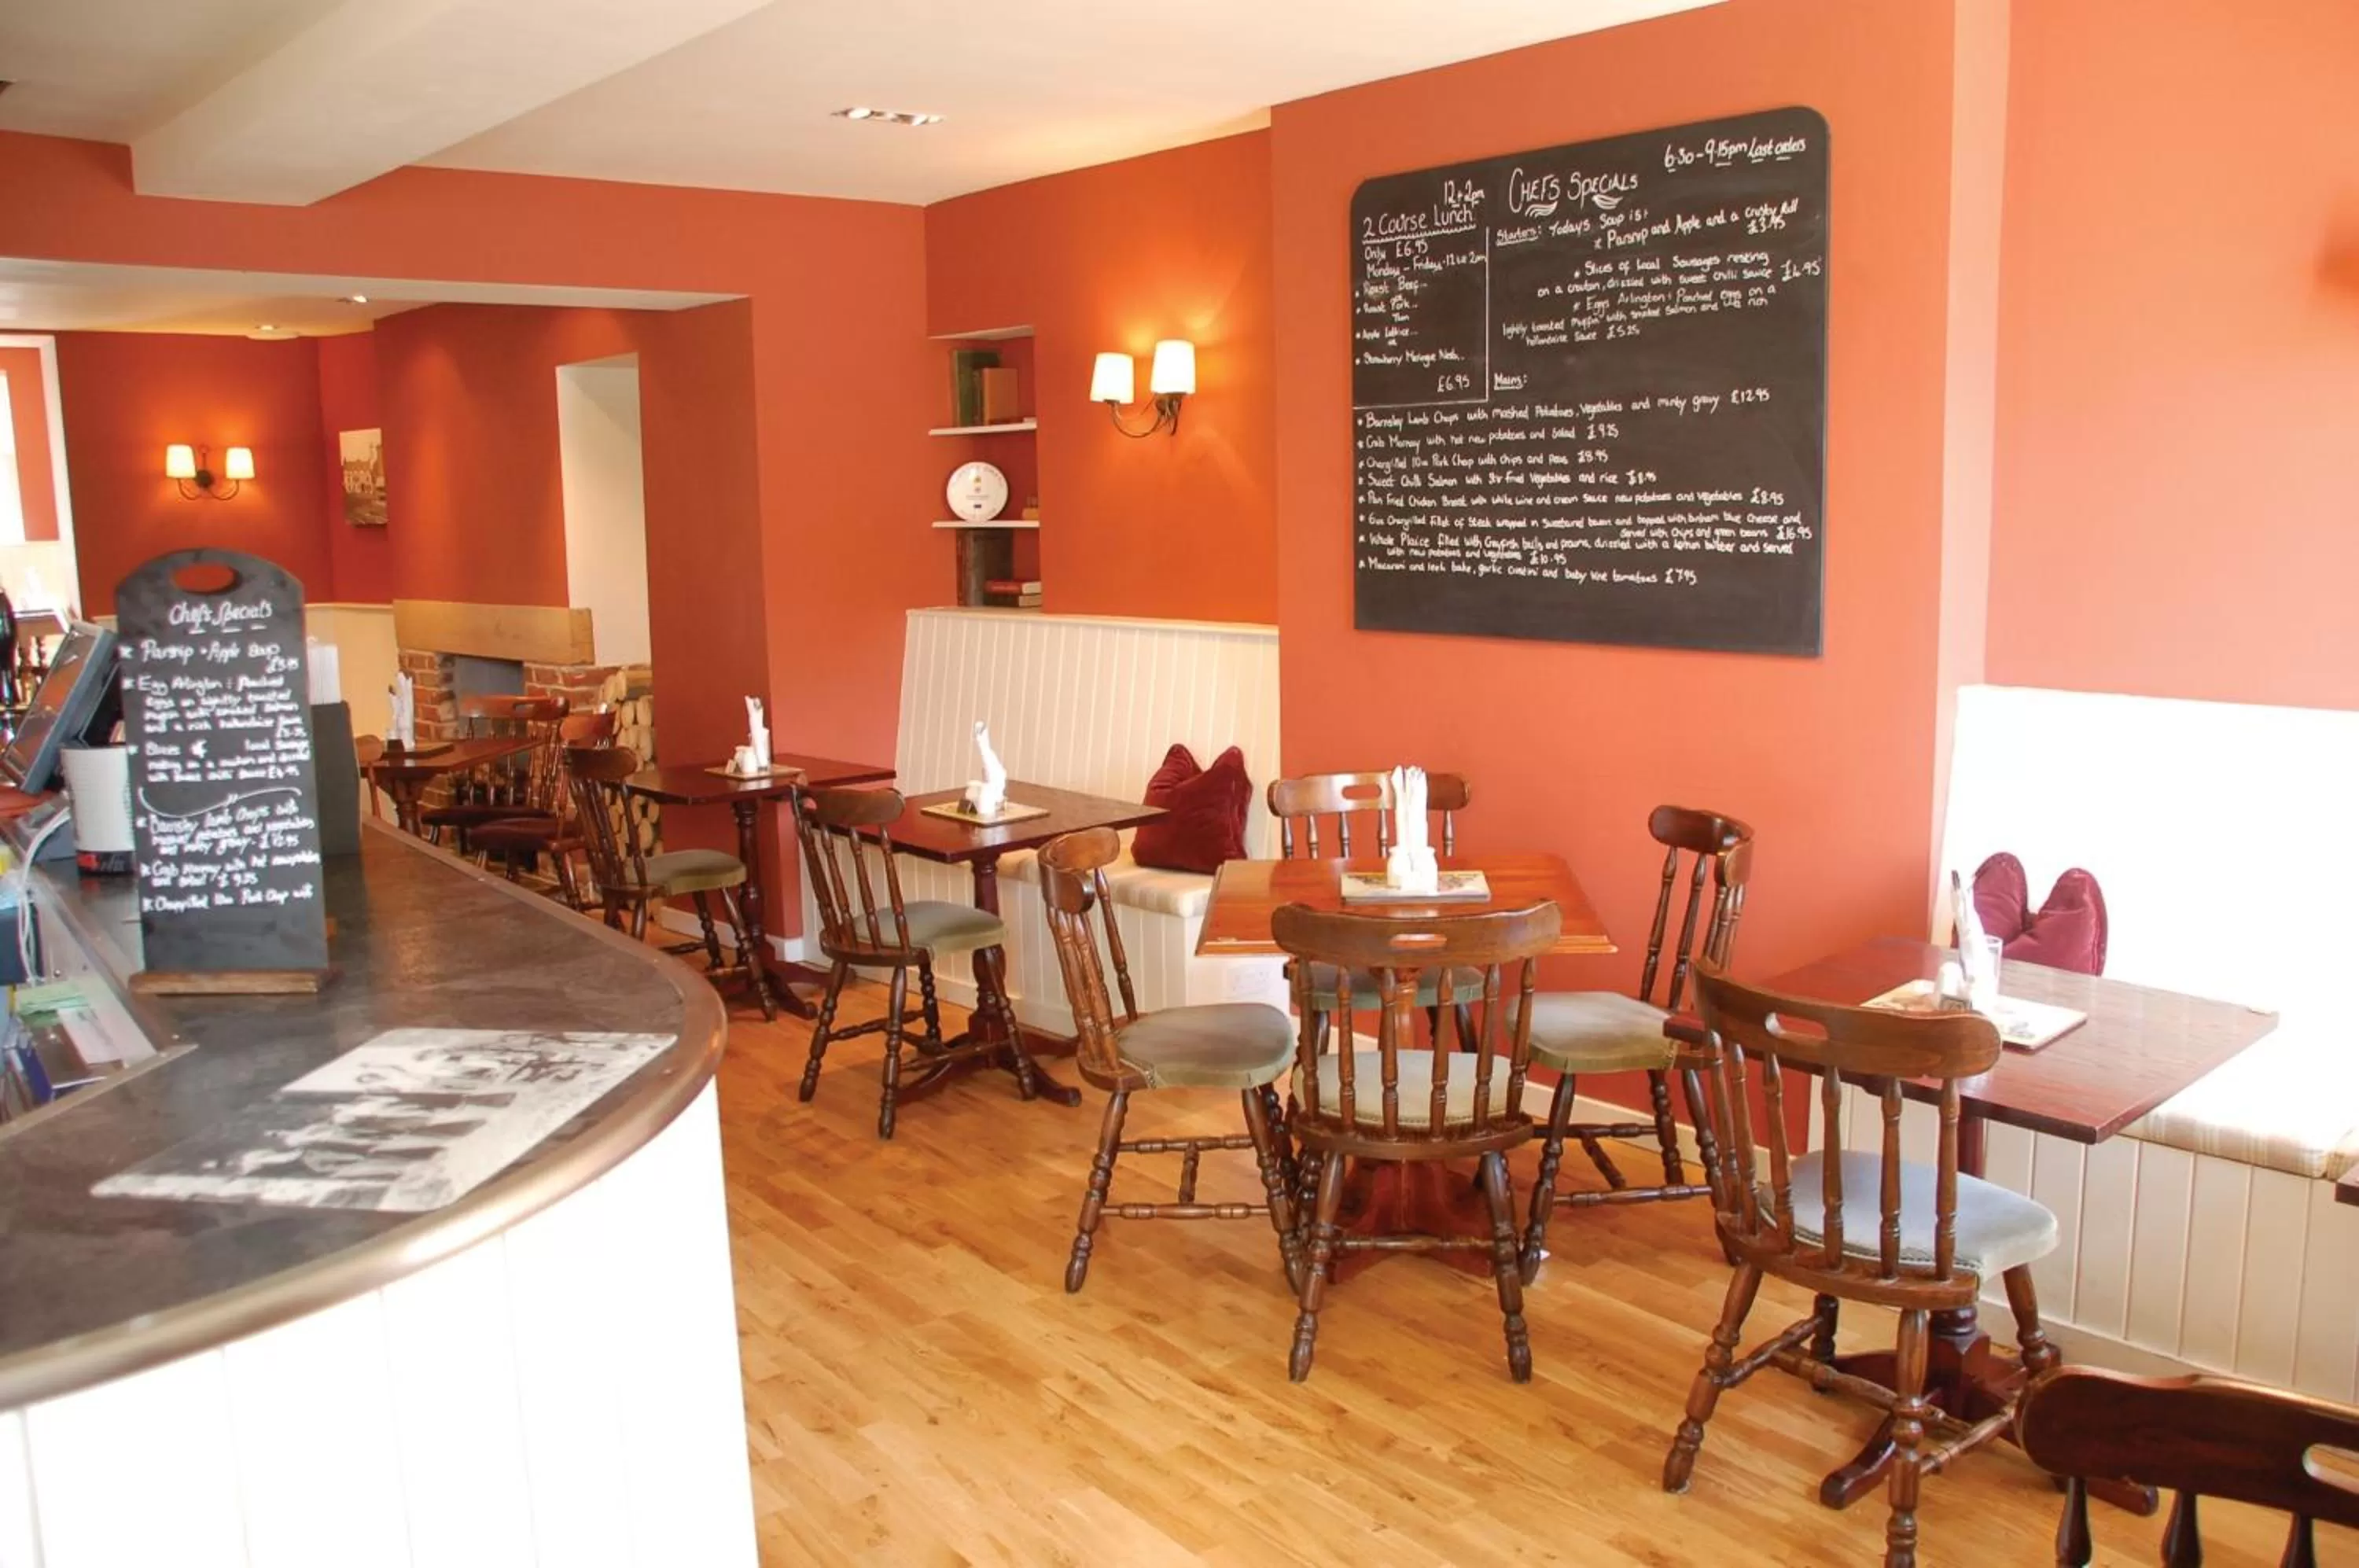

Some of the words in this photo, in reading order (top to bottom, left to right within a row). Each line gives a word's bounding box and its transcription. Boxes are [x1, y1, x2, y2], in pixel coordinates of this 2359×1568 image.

[1747, 137, 1773, 157] Last
[1363, 217, 1375, 237] 2
[1378, 213, 1427, 235] Course
[1433, 204, 1473, 226] Lunch
[1599, 212, 1625, 230] Soup
[1651, 219, 1671, 235] and
[1674, 214, 1701, 236] Apple
[1706, 210, 1726, 226] and
[1731, 212, 1739, 221] a
[1364, 247, 1386, 264] Only
[1618, 260, 1629, 275] of
[1538, 288, 1549, 297] on
[1555, 285, 1563, 294] a
[1651, 274, 1672, 285] with
[1749, 286, 1762, 296] on
[1606, 312, 1626, 322] with
[1701, 302, 1719, 311] and
[1467, 406, 1488, 421] with
[1631, 397, 1650, 410] and
[1426, 434, 1445, 445] with
[1530, 428, 1544, 440] and
[1478, 453, 1496, 466] with
[1527, 453, 1544, 465] and
[1465, 474, 1481, 484] with
[1579, 473, 1595, 484] and
[1470, 495, 1487, 506] with
[1536, 494, 1551, 505] and
[1676, 492, 1695, 502] and
[1614, 516, 1632, 525] and
[1667, 514, 1686, 525] with
[1783, 511, 1801, 525] and
[1695, 527, 1710, 538] and
[1464, 535, 1481, 547] with
[1636, 539, 1658, 549] with
[1740, 543, 1760, 553] and
[1409, 562, 1425, 572] and
